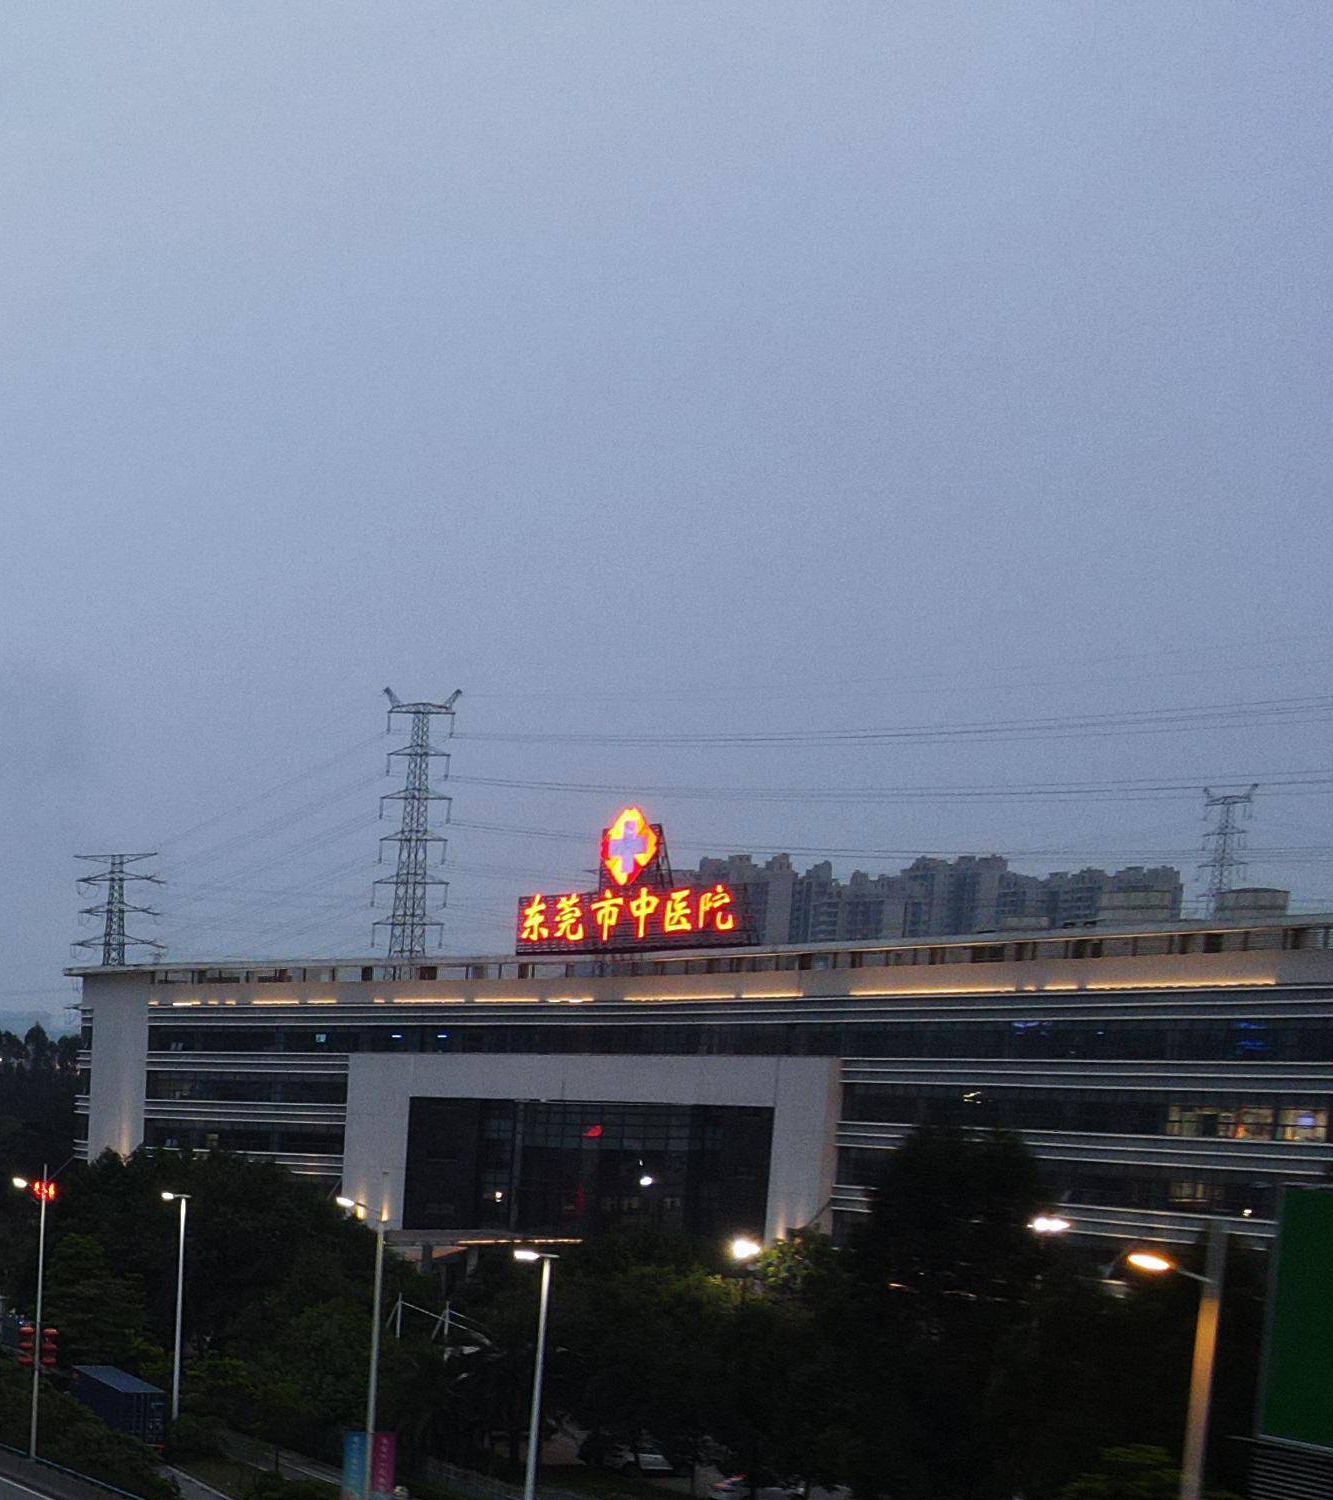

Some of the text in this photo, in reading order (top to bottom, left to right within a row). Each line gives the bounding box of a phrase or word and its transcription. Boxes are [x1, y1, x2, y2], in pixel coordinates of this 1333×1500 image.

[521, 884, 736, 941] 东莞市中医院
